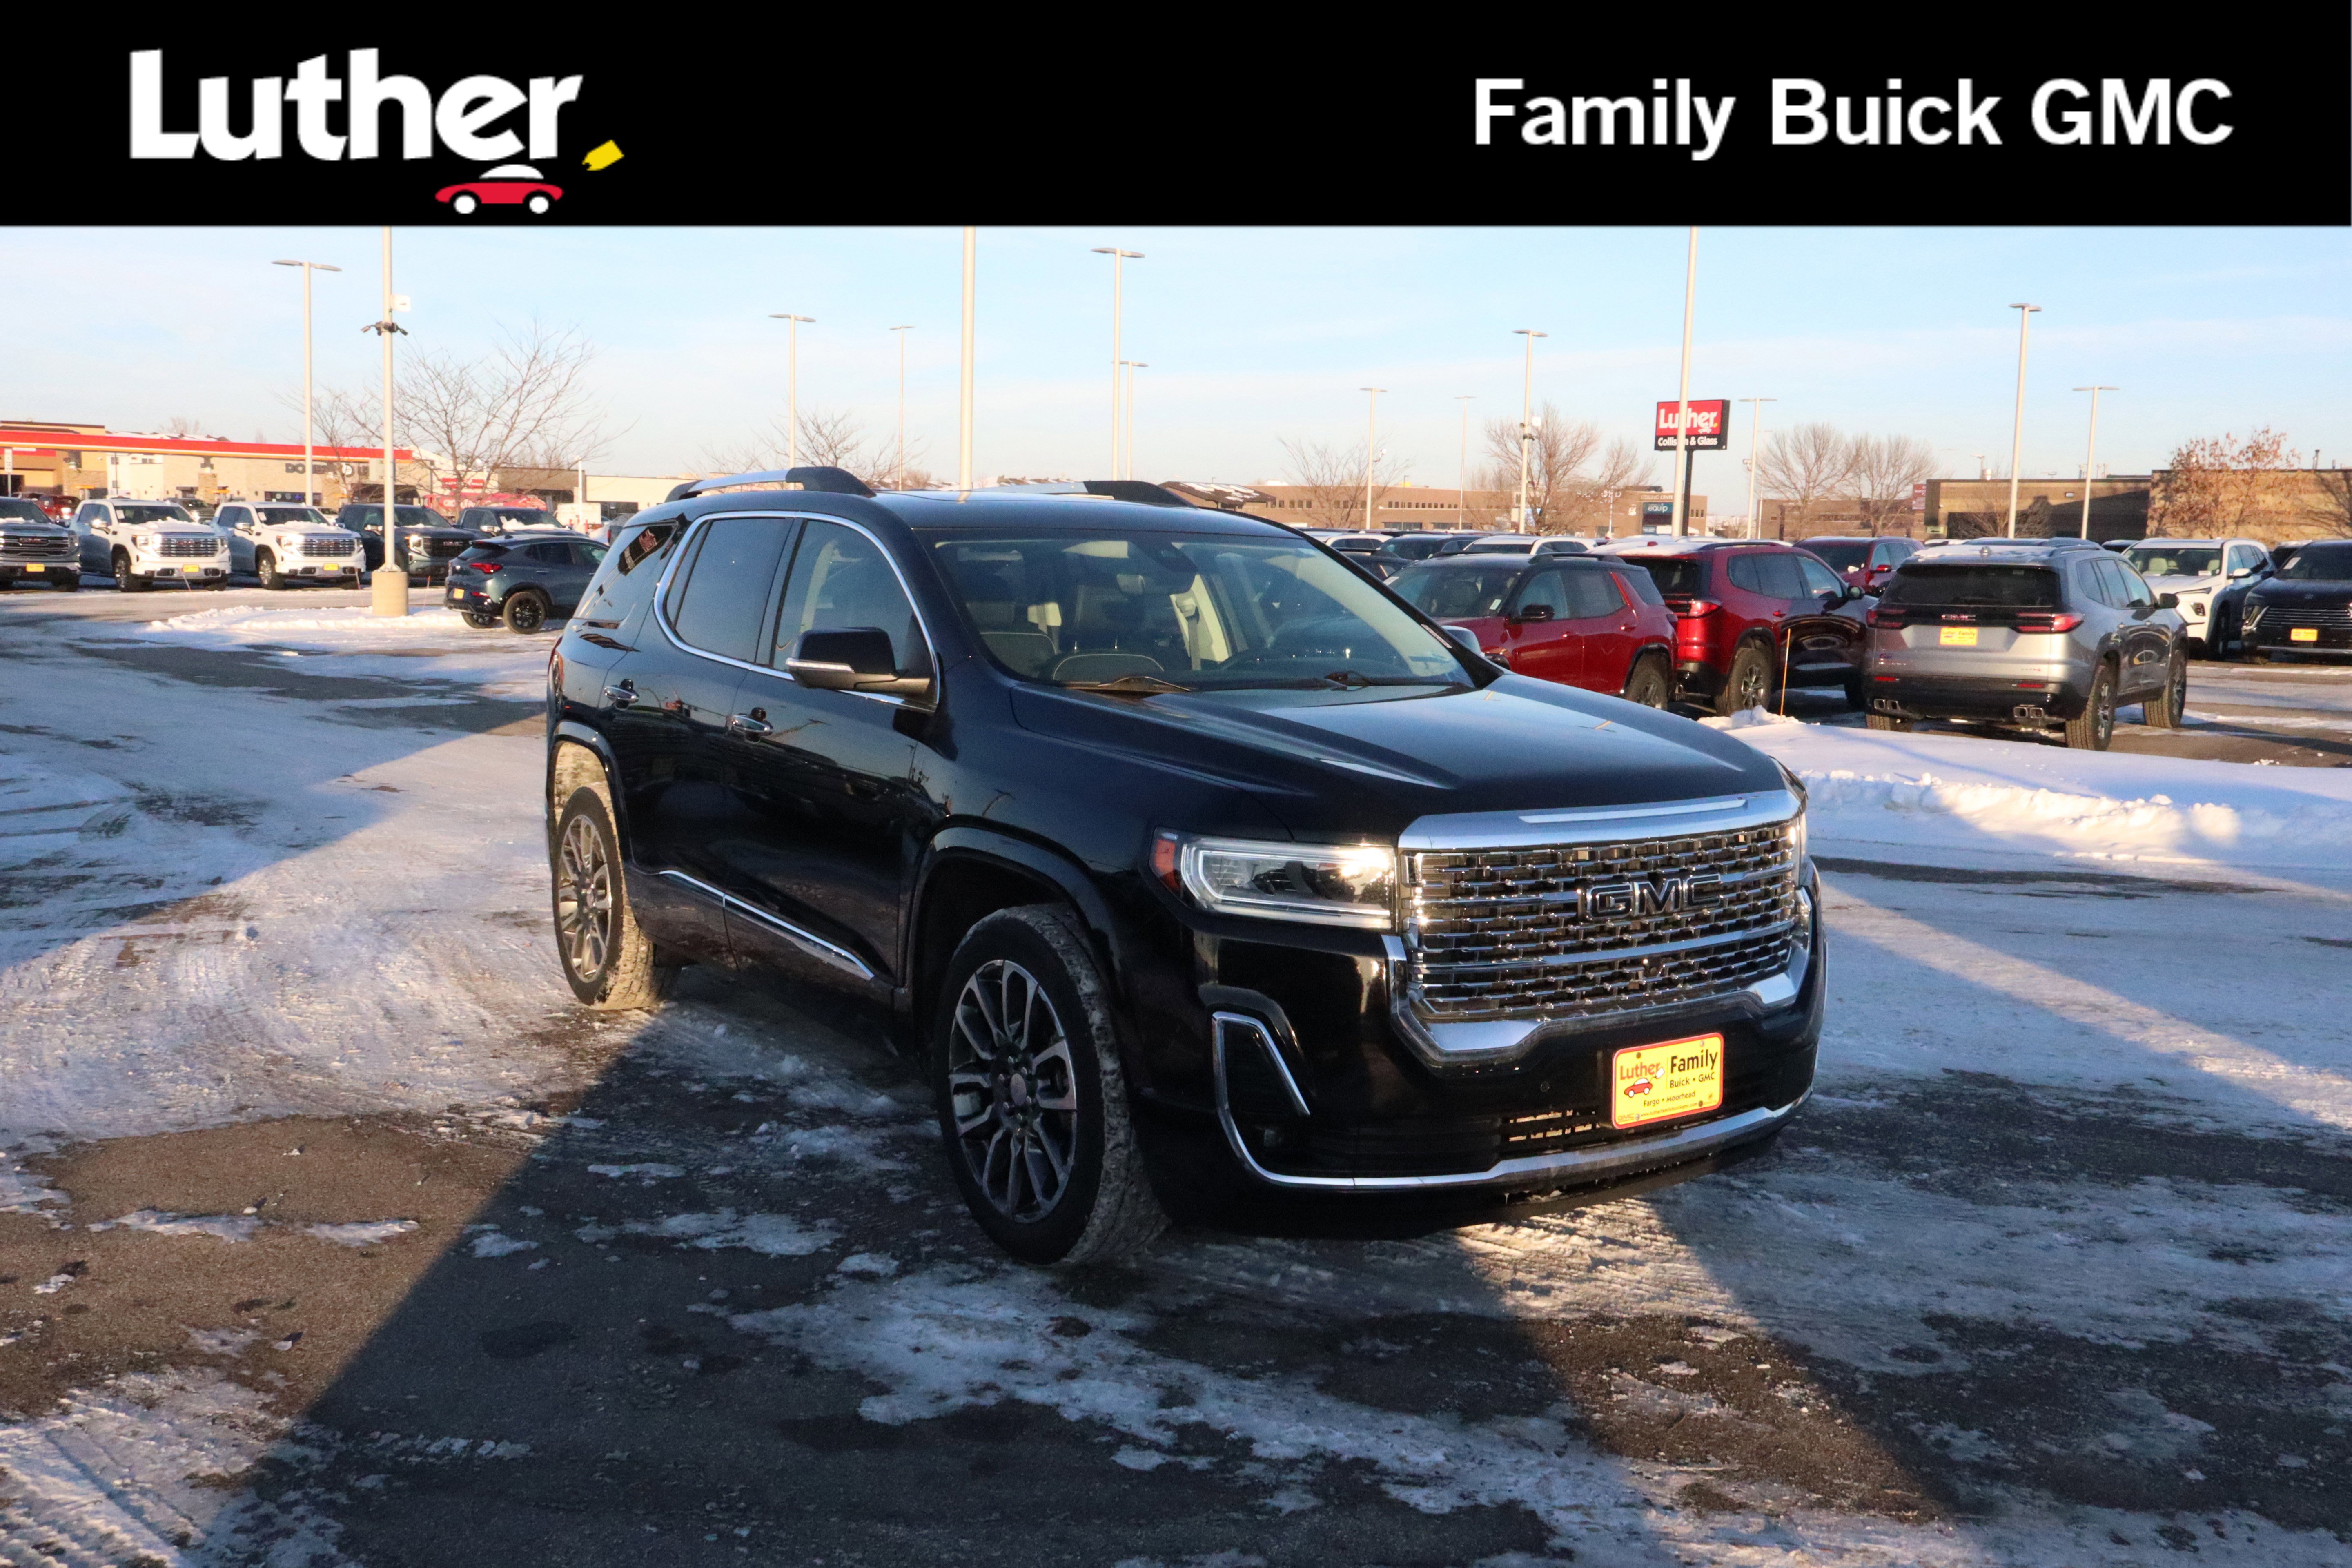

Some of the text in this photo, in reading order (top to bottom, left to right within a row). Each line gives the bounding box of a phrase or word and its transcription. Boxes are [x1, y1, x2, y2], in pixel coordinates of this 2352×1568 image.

[1659, 408, 1717, 428] Luher
[1658, 436, 1717, 446] Collisn & Glass
[1648, 503, 1668, 512] equip
[1586, 873, 1721, 919] GMC
[1670, 1049, 1718, 1074] Family
[1620, 1062, 1661, 1080] Luther
[1670, 1071, 1715, 1088] Buick GMC
[1666, 1090, 1695, 1102] Moorhead
[1617, 1113, 1634, 1121] GMC
